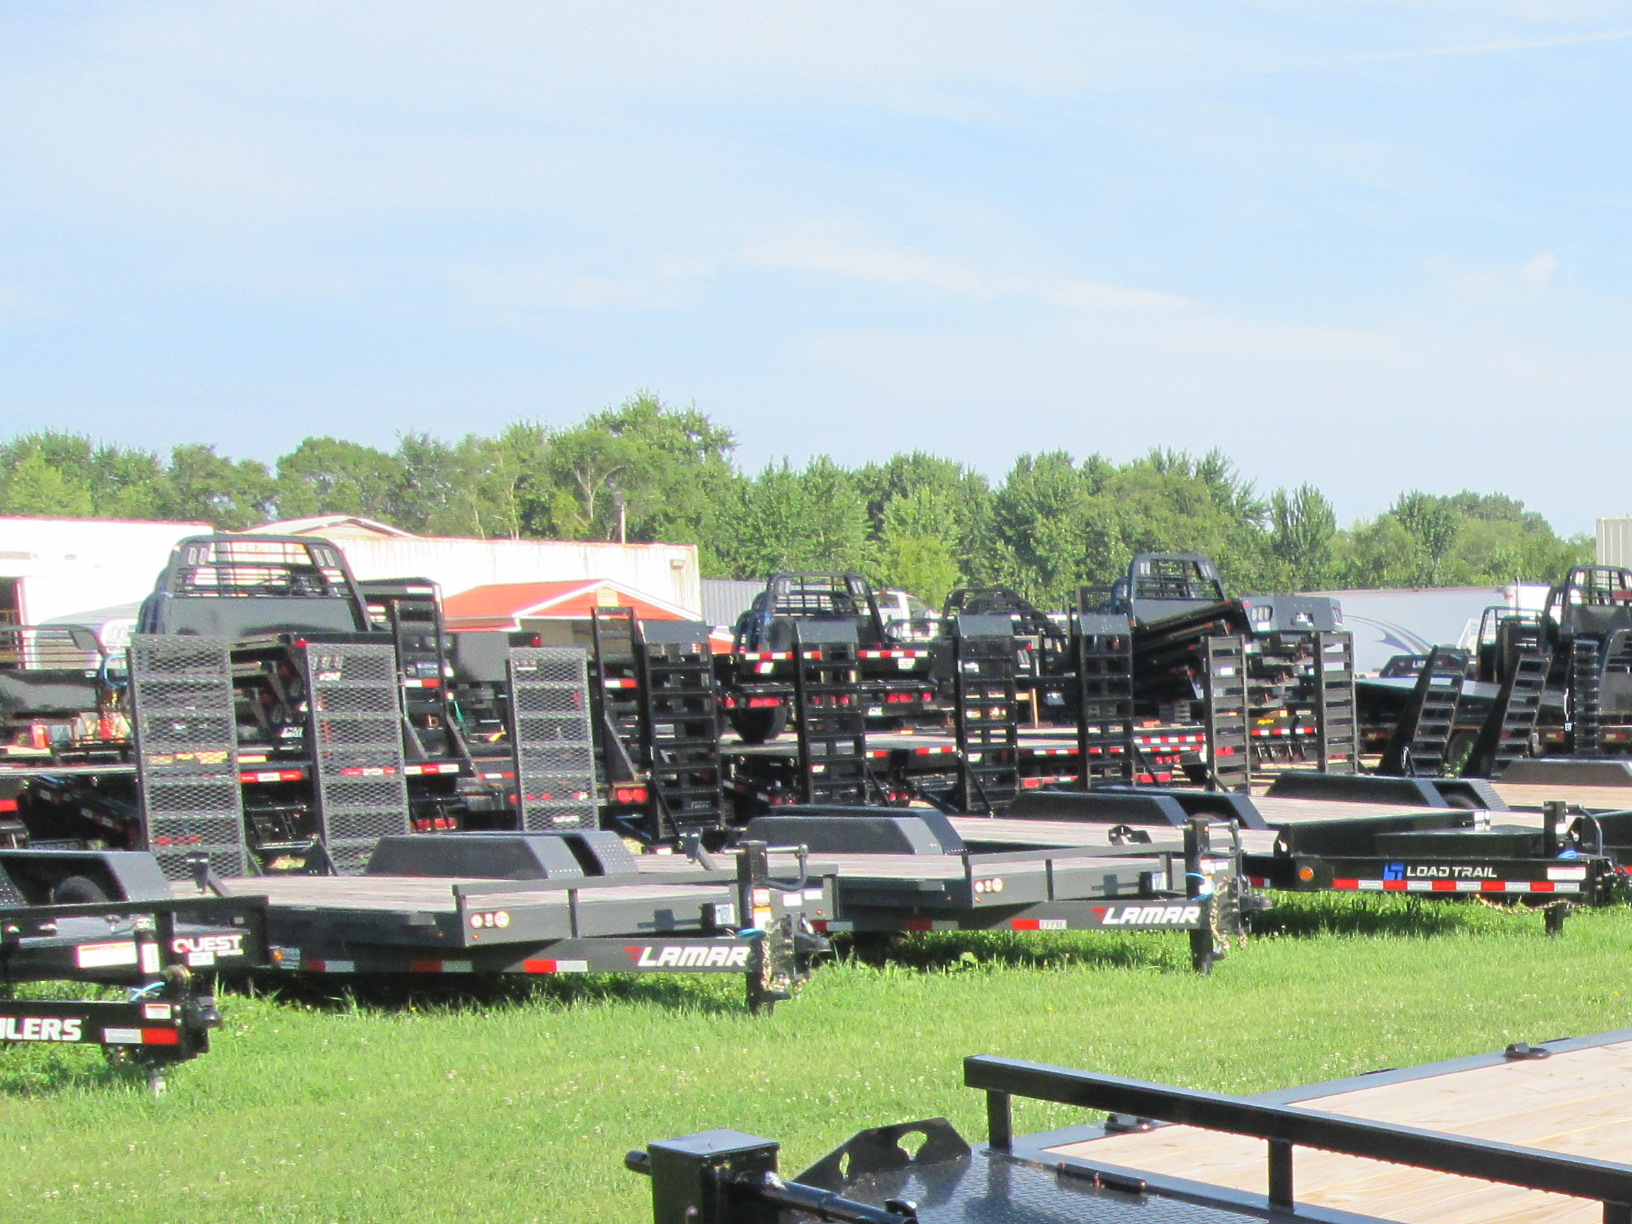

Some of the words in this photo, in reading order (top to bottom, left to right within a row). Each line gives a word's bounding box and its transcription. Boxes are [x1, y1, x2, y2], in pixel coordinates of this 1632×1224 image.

[1406, 866, 1450, 878] LOAD
[1452, 867, 1498, 878] TRAIL
[1101, 906, 1201, 924] LAMAR
[172, 934, 243, 954] QUEST
[637, 946, 751, 967] LAMAR
